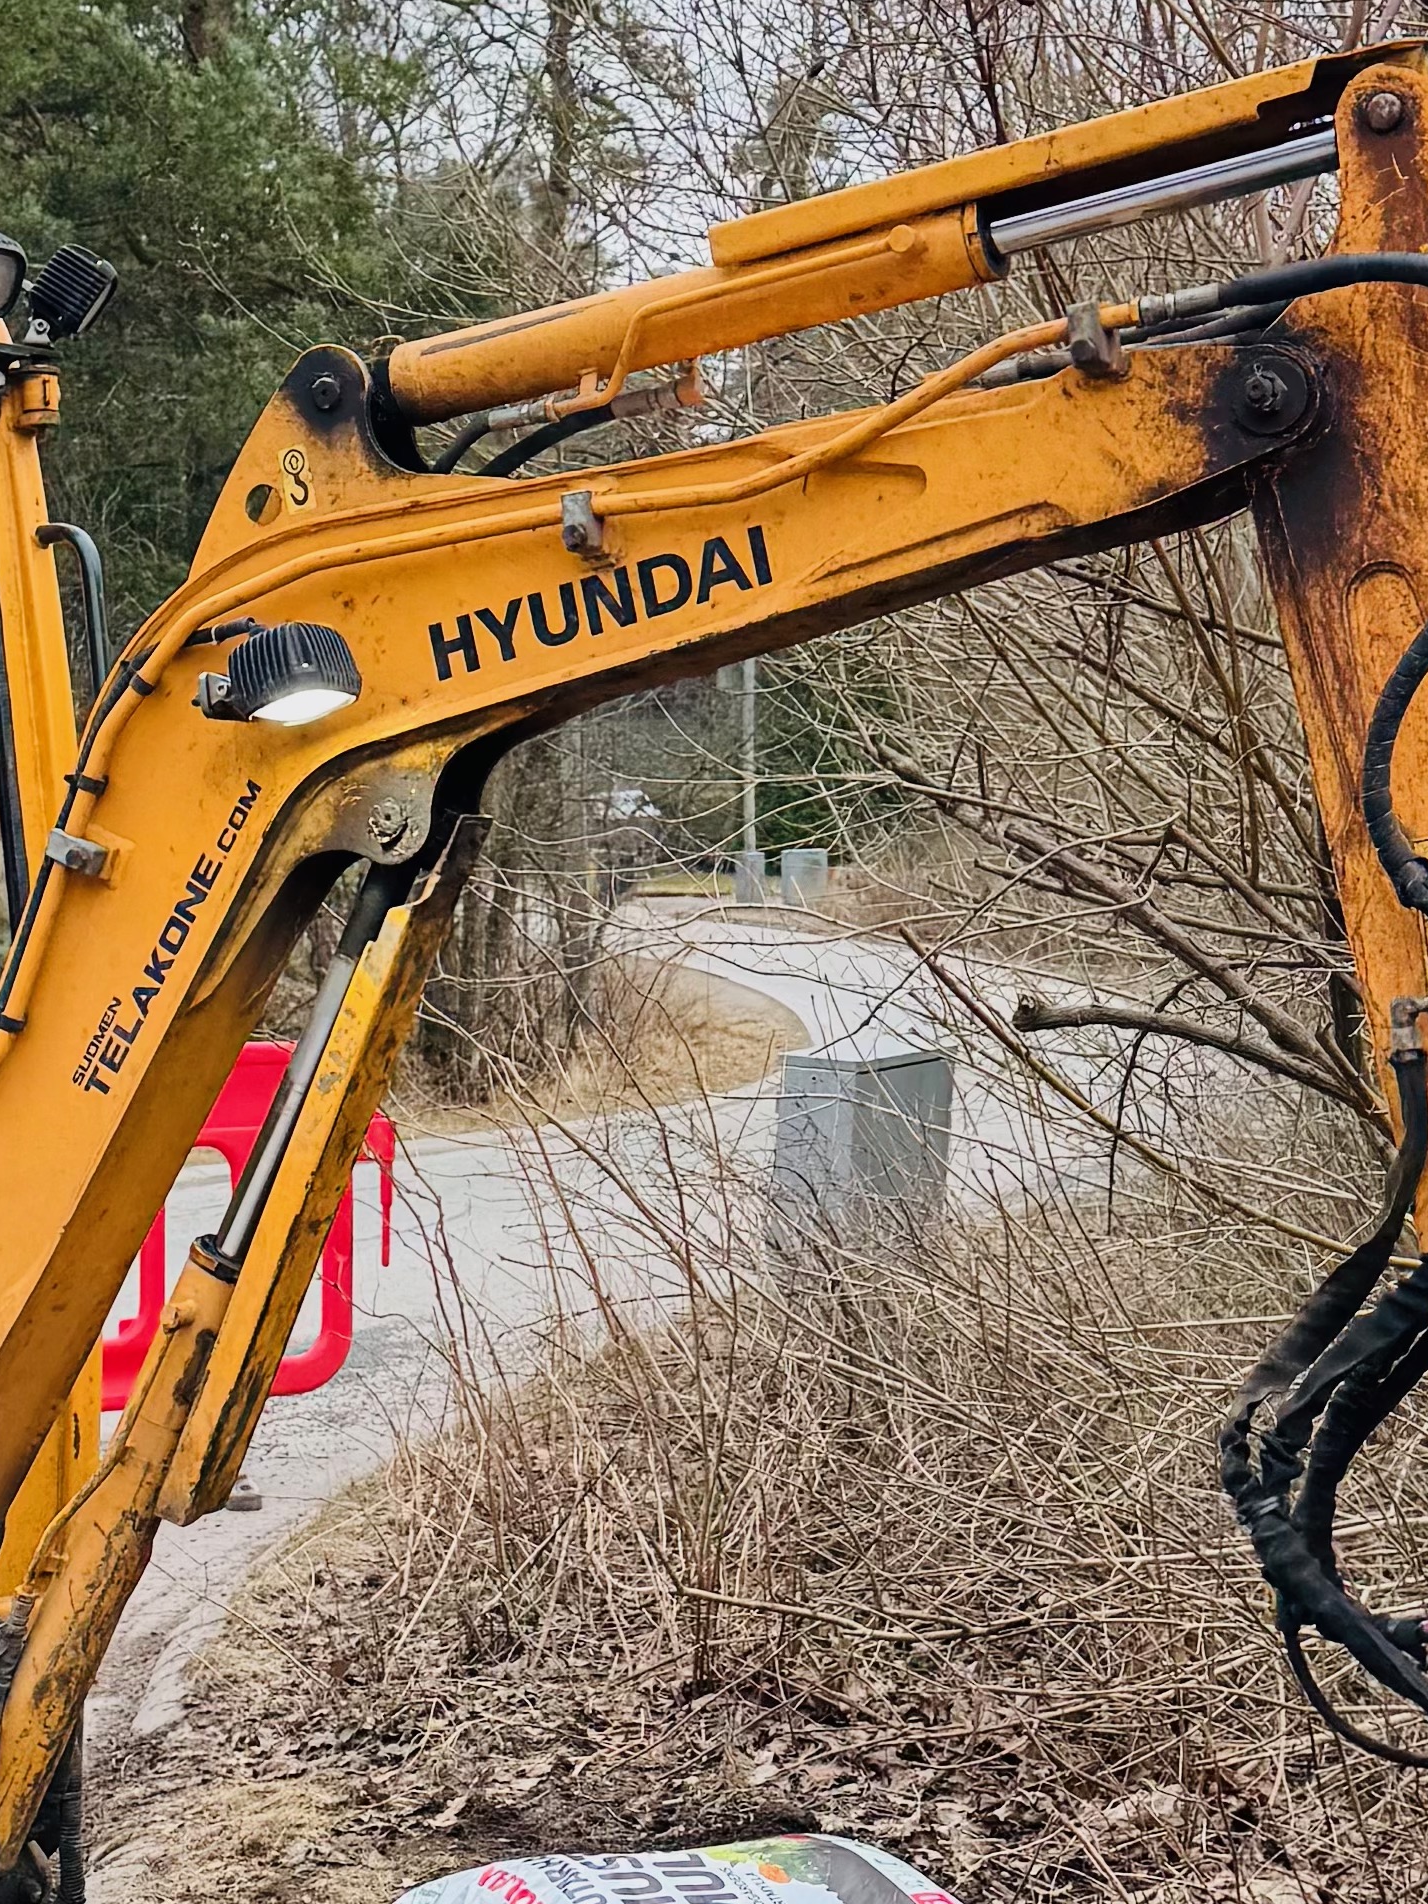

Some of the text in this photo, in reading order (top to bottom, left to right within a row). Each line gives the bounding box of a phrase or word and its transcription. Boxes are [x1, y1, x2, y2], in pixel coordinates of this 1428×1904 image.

[428, 525, 772, 681] HYUNDAI
[84, 778, 262, 1095] TELAKONE.COM
[72, 996, 122, 1086] SUOMEN
